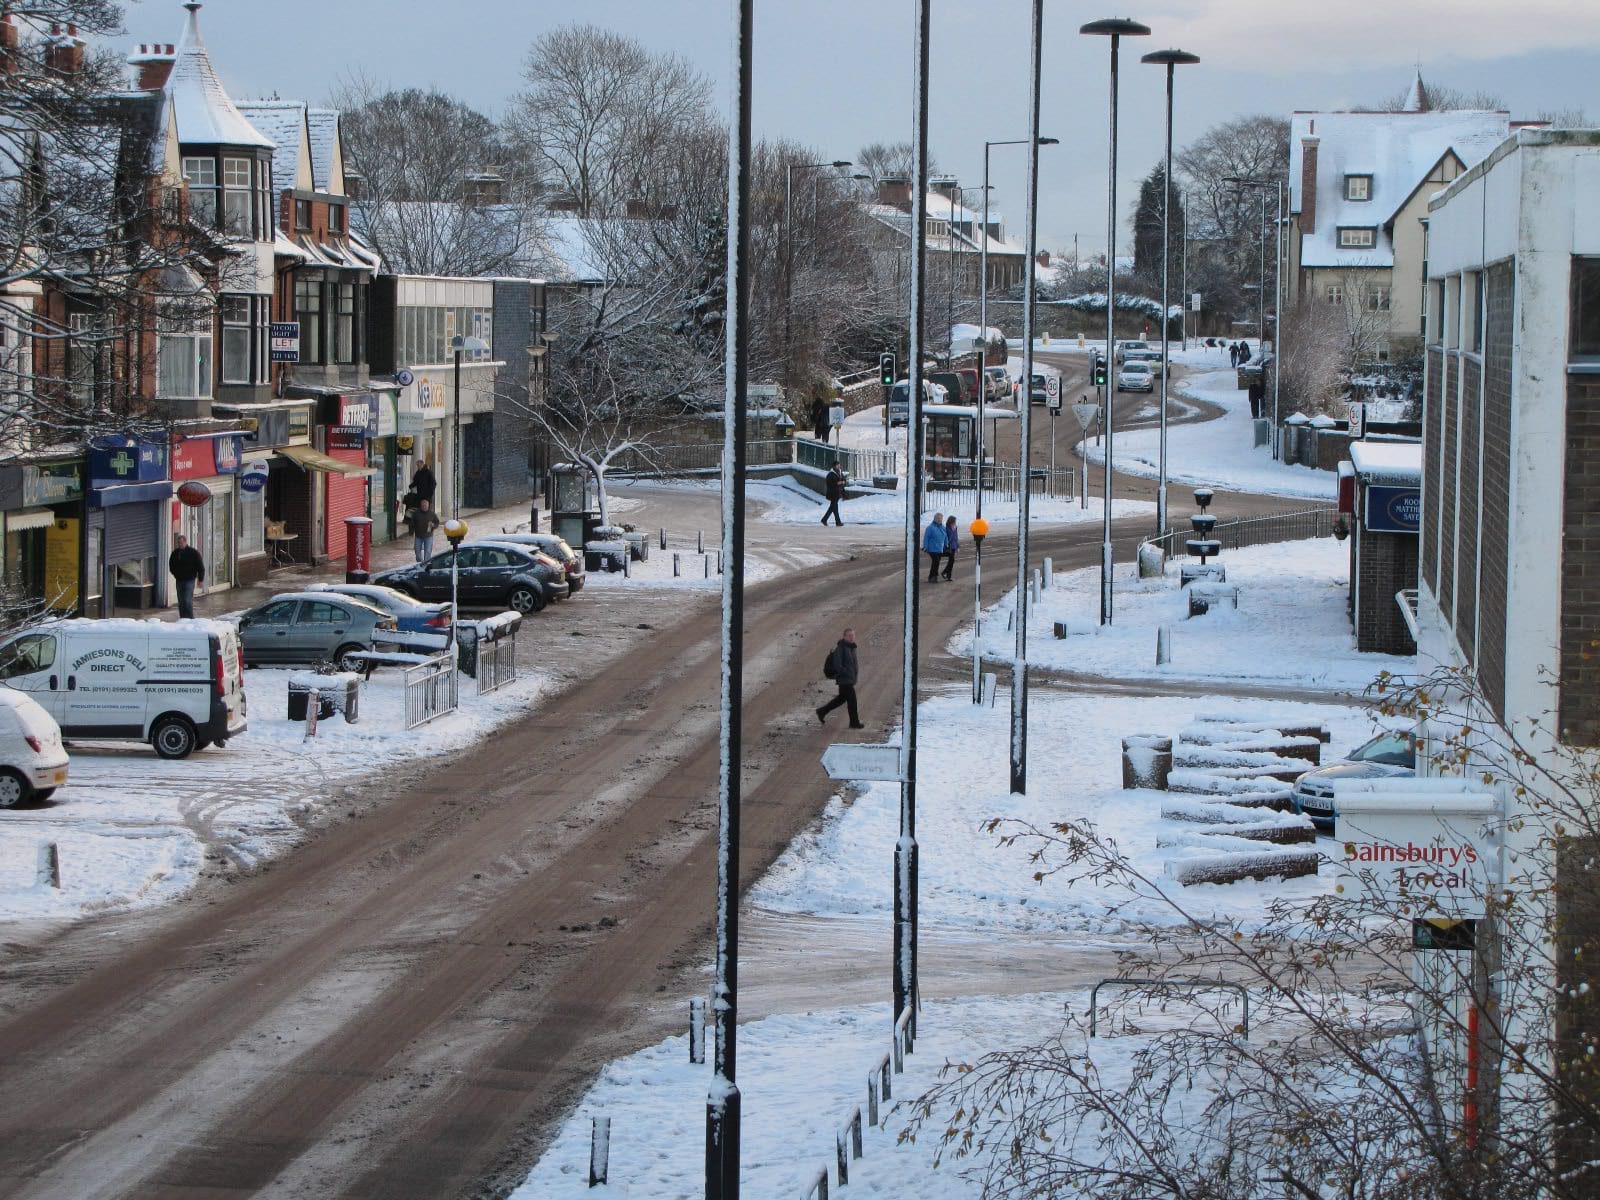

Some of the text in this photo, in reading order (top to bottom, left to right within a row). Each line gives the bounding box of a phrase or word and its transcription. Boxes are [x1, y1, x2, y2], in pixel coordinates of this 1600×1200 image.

[275, 338, 296, 347] LET
[342, 403, 370, 428] BETFRED
[1403, 498, 1421, 506] ROO
[1403, 513, 1421, 521] SAYE
[72, 648, 147, 673] JAMIESONS DELI
[90, 664, 126, 672] DIRECT
[1344, 841, 1477, 868] Sainsbury's
[1399, 867, 1467, 889] Local
